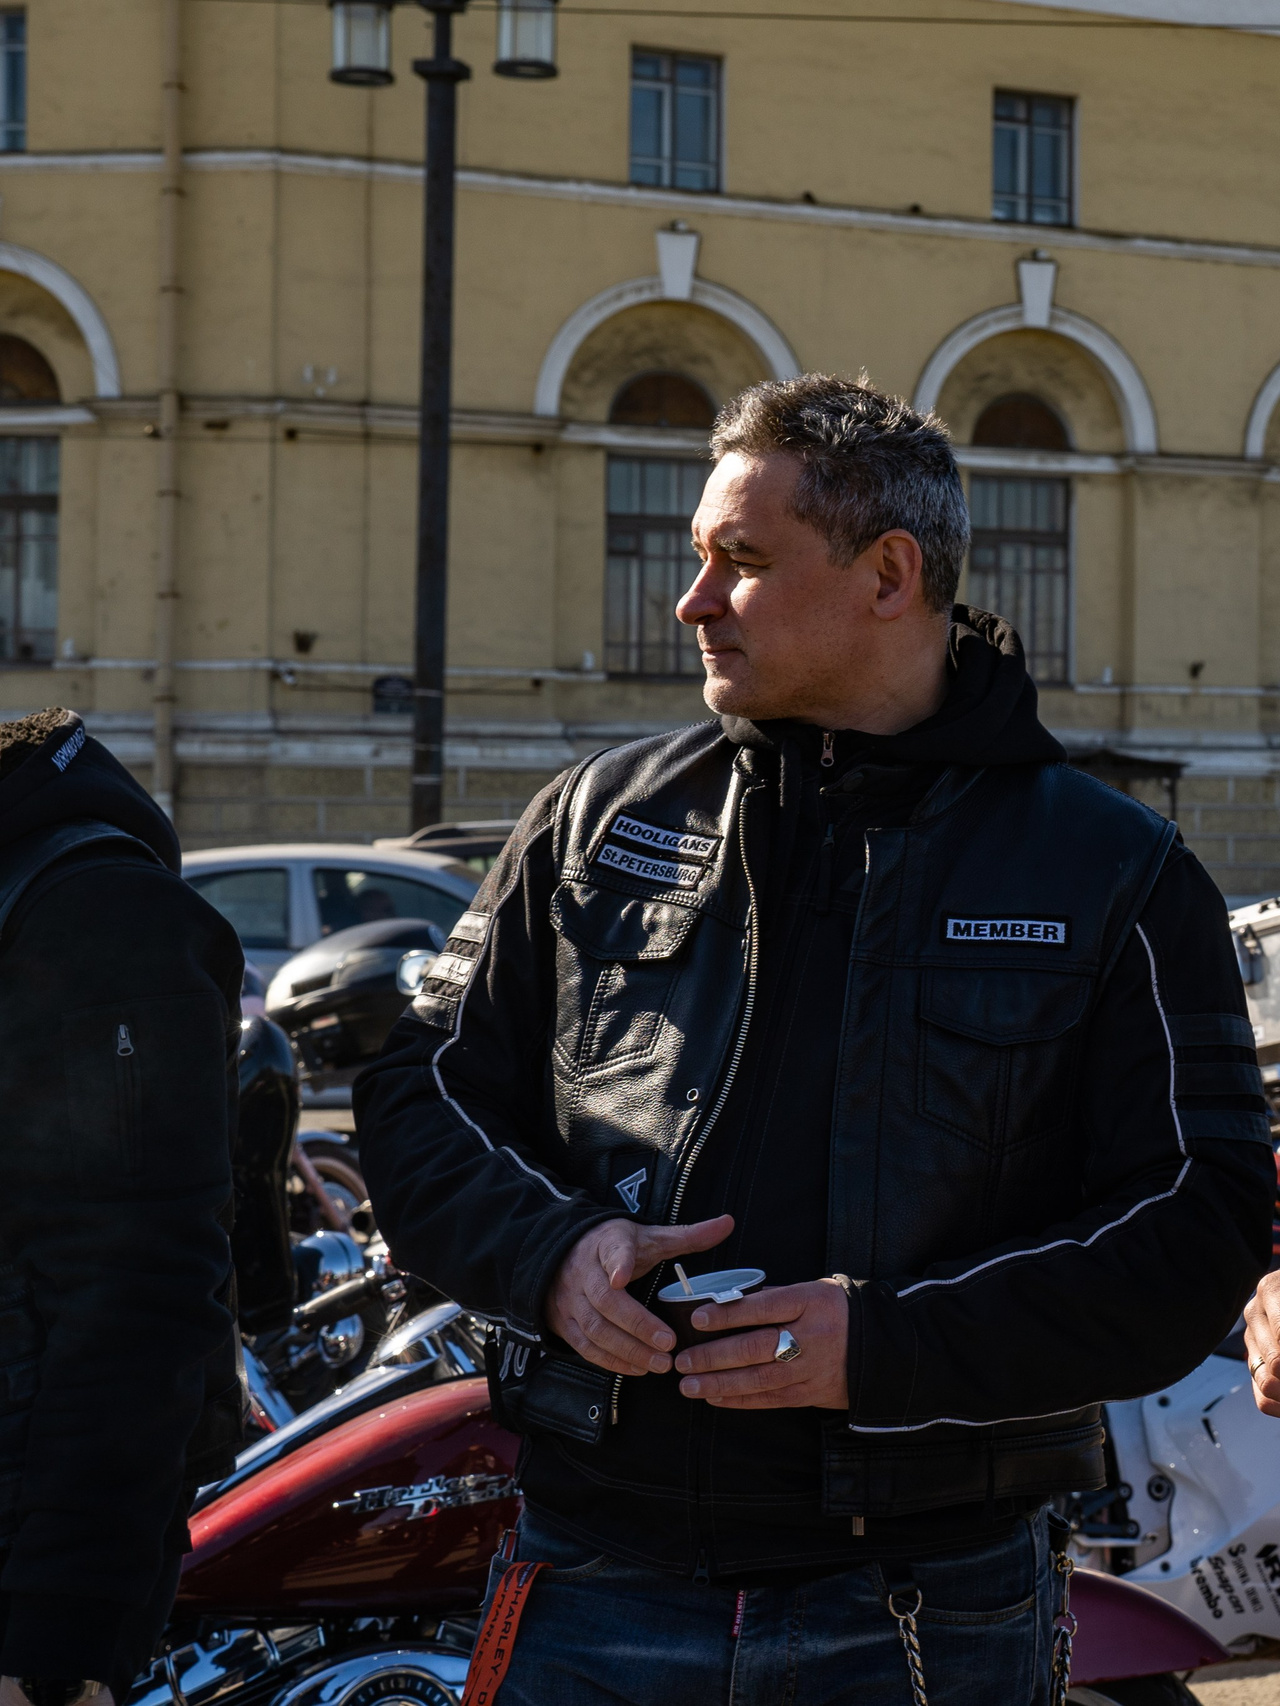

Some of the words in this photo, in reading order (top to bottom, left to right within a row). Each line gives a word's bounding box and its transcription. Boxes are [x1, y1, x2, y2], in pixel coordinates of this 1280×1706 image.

[615, 820, 711, 852] HOOLIGANS
[602, 848, 697, 882] St.PETERSBURG
[951, 922, 1060, 942] MEMBER
[1189, 1555, 1224, 1619] brembo
